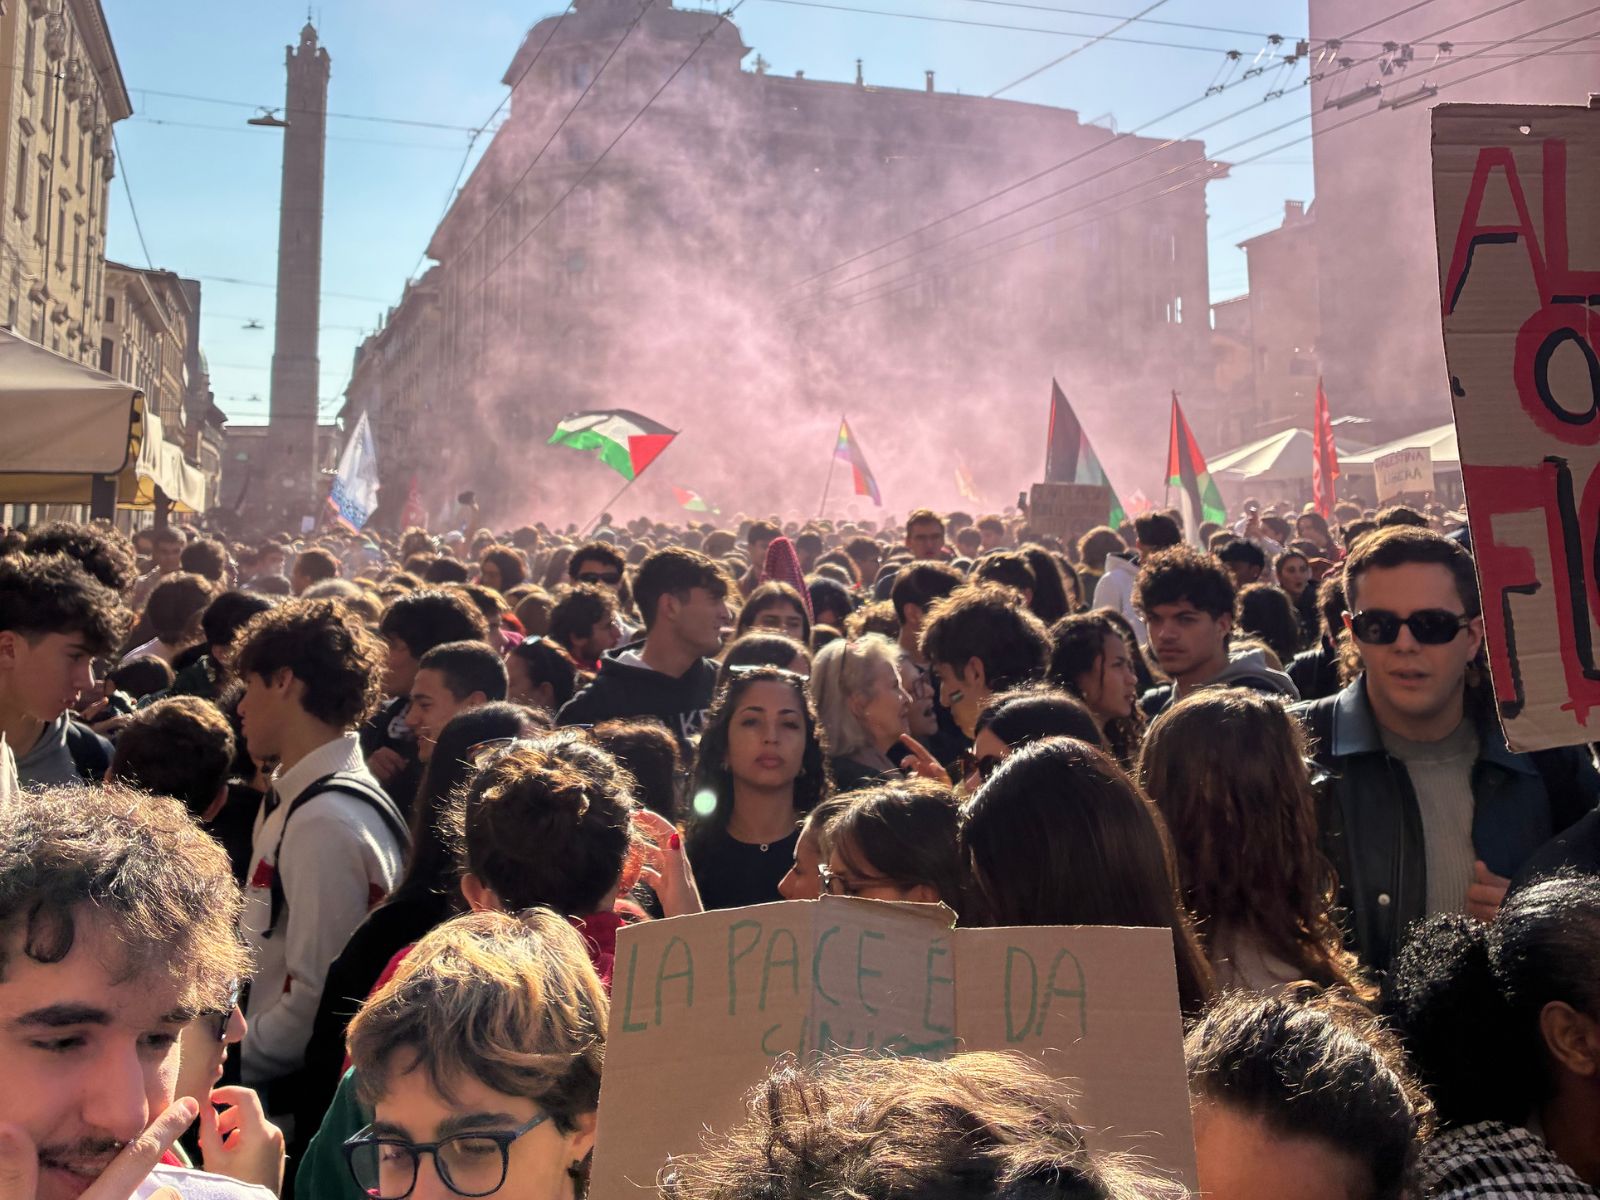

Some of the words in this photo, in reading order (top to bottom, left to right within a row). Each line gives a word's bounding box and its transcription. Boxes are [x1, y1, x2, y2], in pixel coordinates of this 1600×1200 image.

[623, 936, 694, 1032] LA
[728, 919, 885, 1016] PACE
[1004, 945, 1088, 1043] DA
